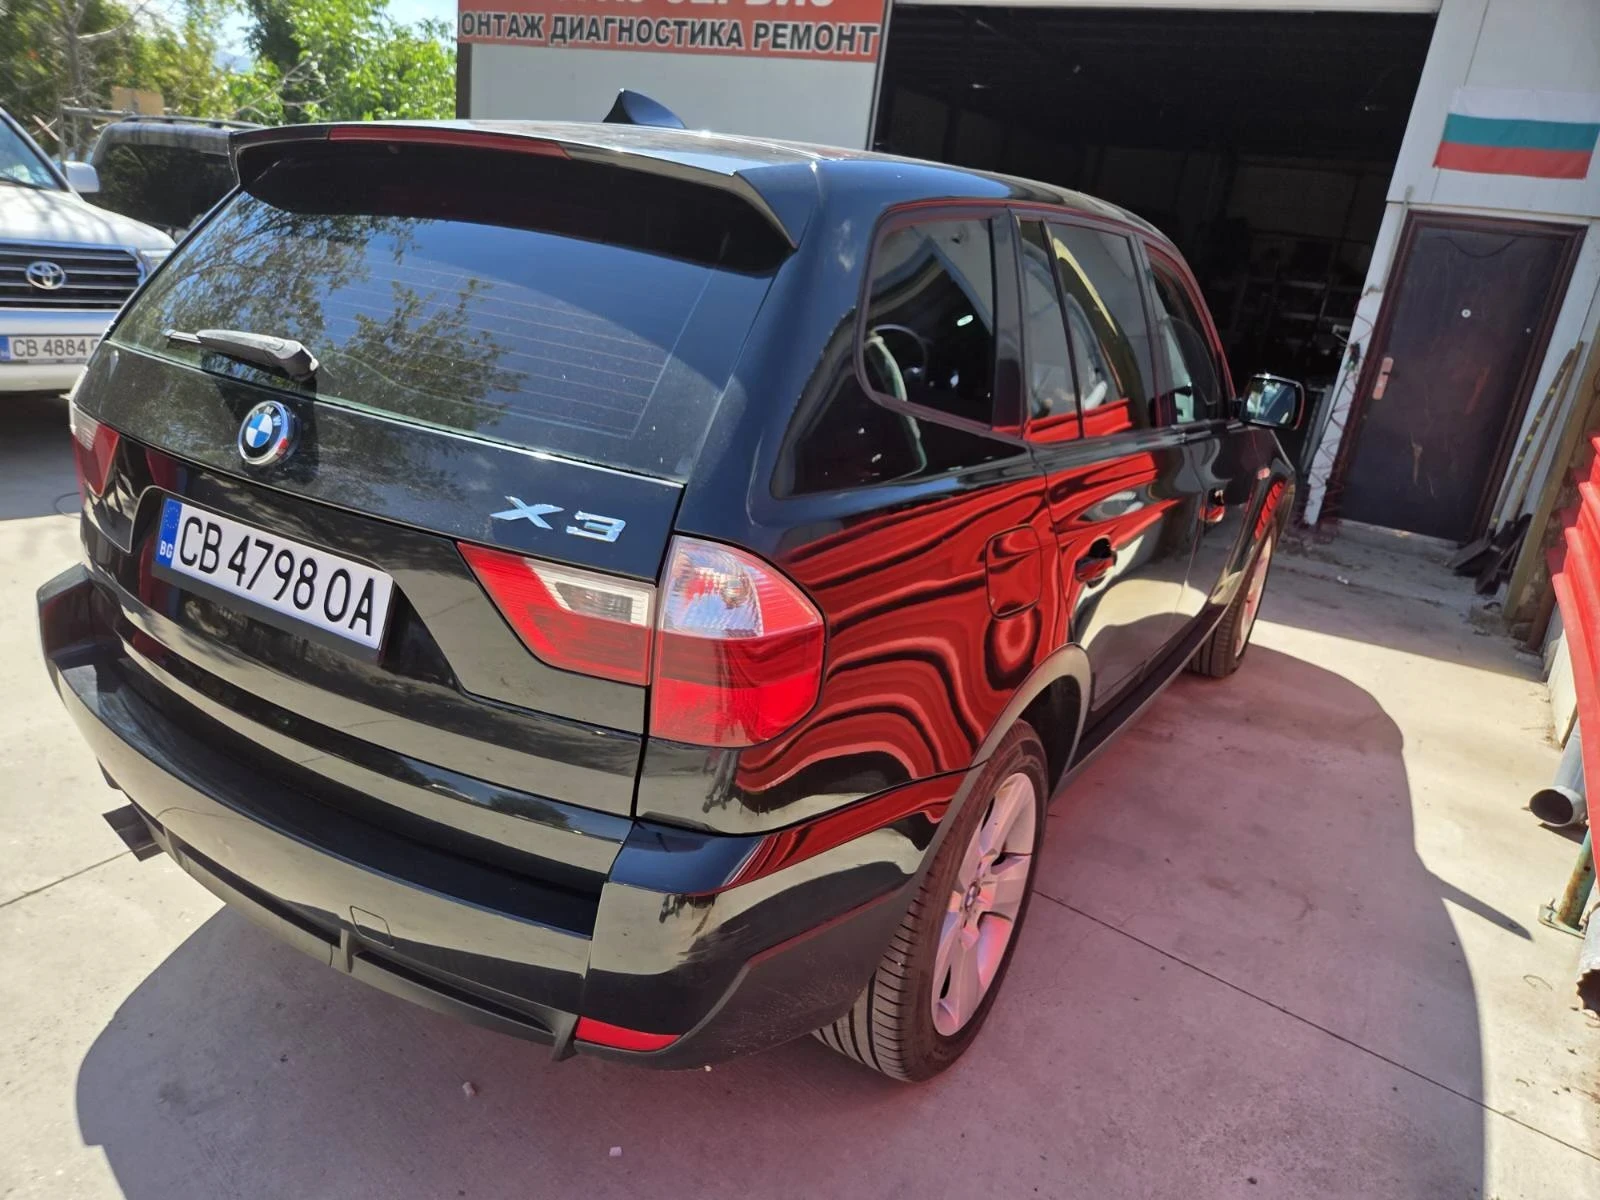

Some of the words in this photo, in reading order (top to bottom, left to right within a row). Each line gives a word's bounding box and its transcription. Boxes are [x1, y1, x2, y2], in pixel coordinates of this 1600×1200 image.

[459, 11, 545, 40] ОНТАЖ
[549, 14, 745, 49] ДИАГНОСТИКА
[753, 21, 881, 55] РЕМОНТ
[13, 338, 39, 357] CB
[43, 338, 87, 357] 4884
[489, 494, 627, 543] X3
[159, 540, 173, 558] BG
[179, 516, 223, 575] CB
[227, 535, 318, 611] 4798
